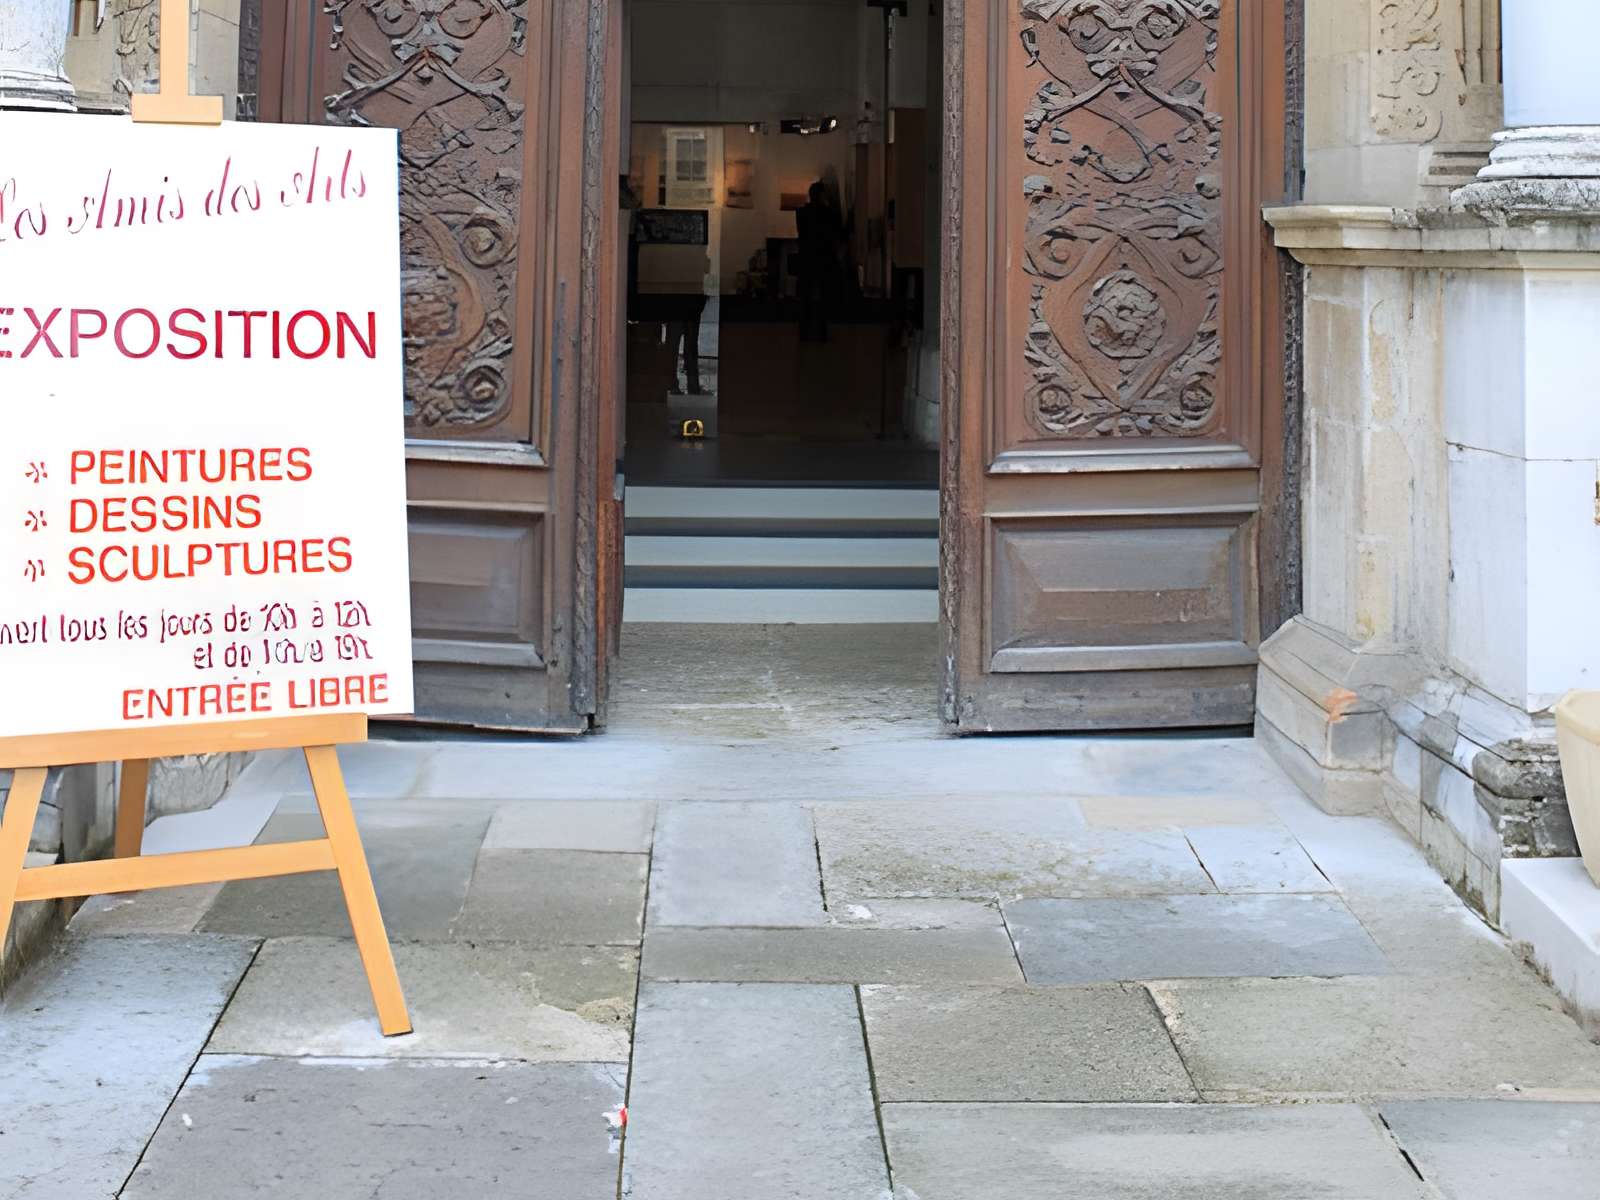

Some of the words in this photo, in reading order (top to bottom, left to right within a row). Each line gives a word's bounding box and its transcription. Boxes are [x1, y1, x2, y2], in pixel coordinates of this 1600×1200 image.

[70, 447, 313, 485] PEINTURES
[69, 493, 262, 534] DESSINS
[67, 536, 353, 585] SCULPTURES
[60, 613, 108, 643] tous
[117, 609, 148, 641] les
[160, 608, 213, 644] jours
[193, 642, 214, 669] et
[287, 672, 389, 710] LIBRE
